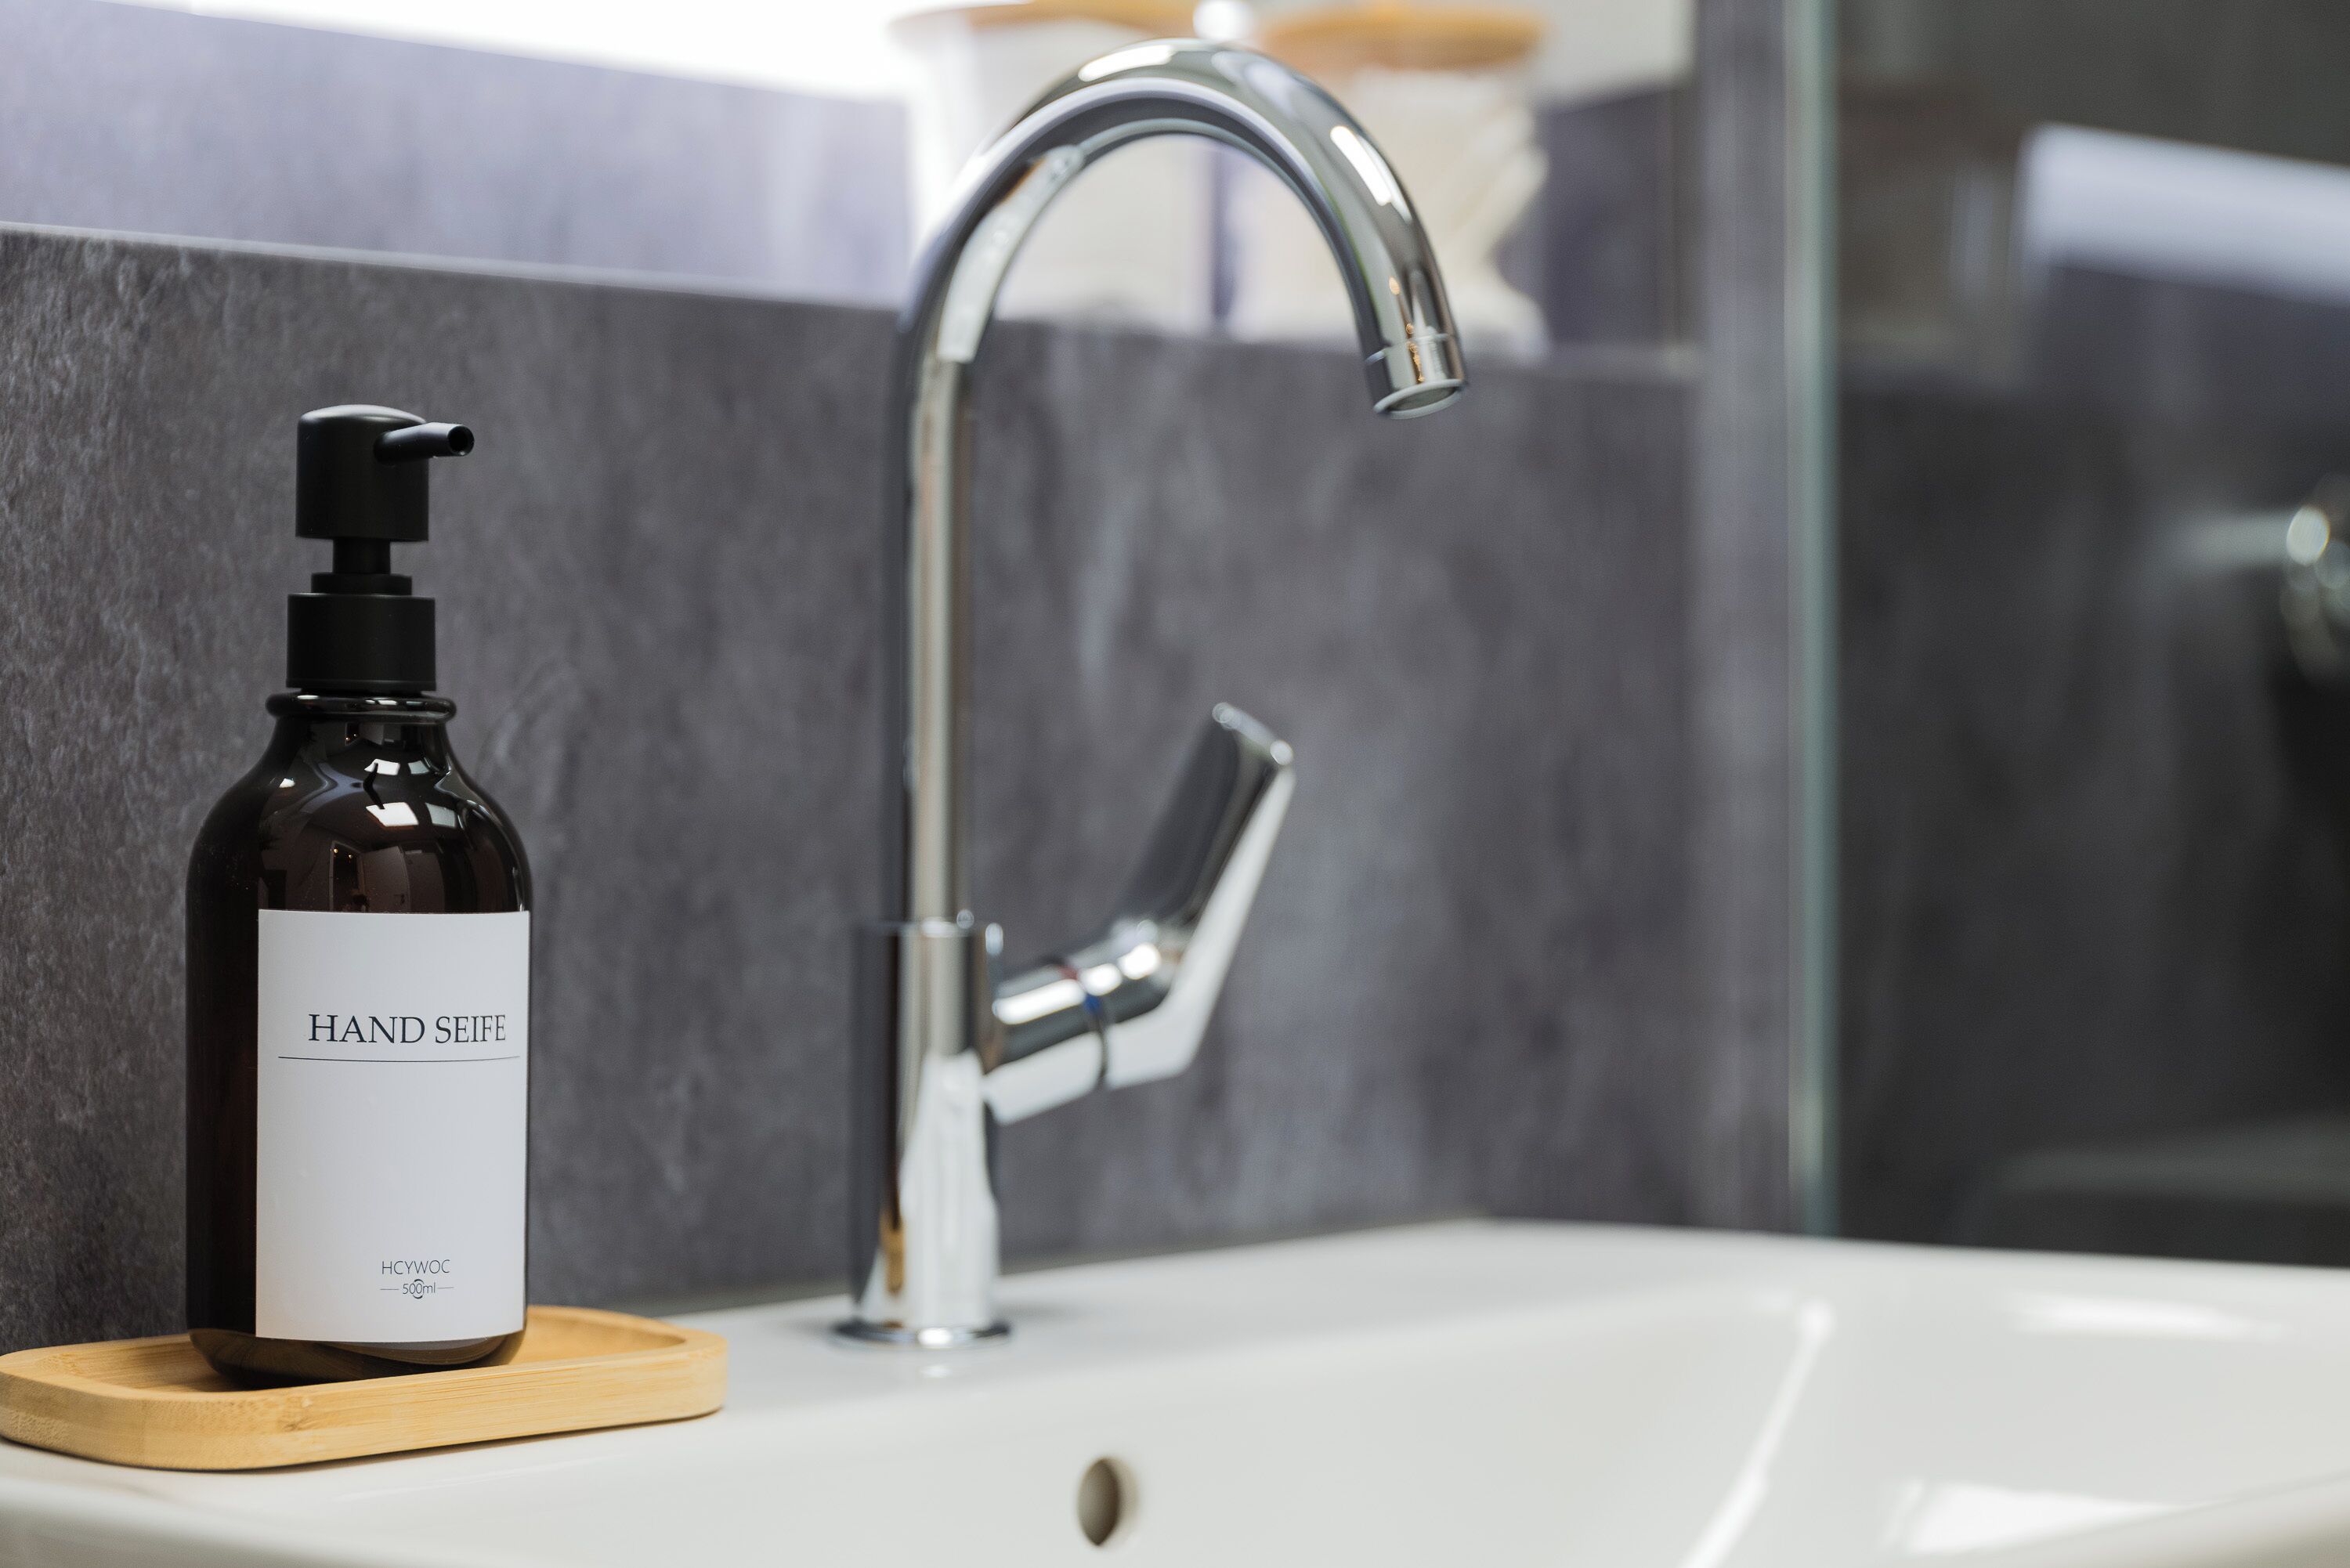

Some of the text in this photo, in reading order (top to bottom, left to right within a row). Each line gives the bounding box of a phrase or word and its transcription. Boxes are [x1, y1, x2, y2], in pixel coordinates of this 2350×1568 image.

[309, 1013, 507, 1044] HAND SEIFE
[381, 1259, 450, 1275] HCYWOC
[402, 1281, 436, 1295] 500ml
